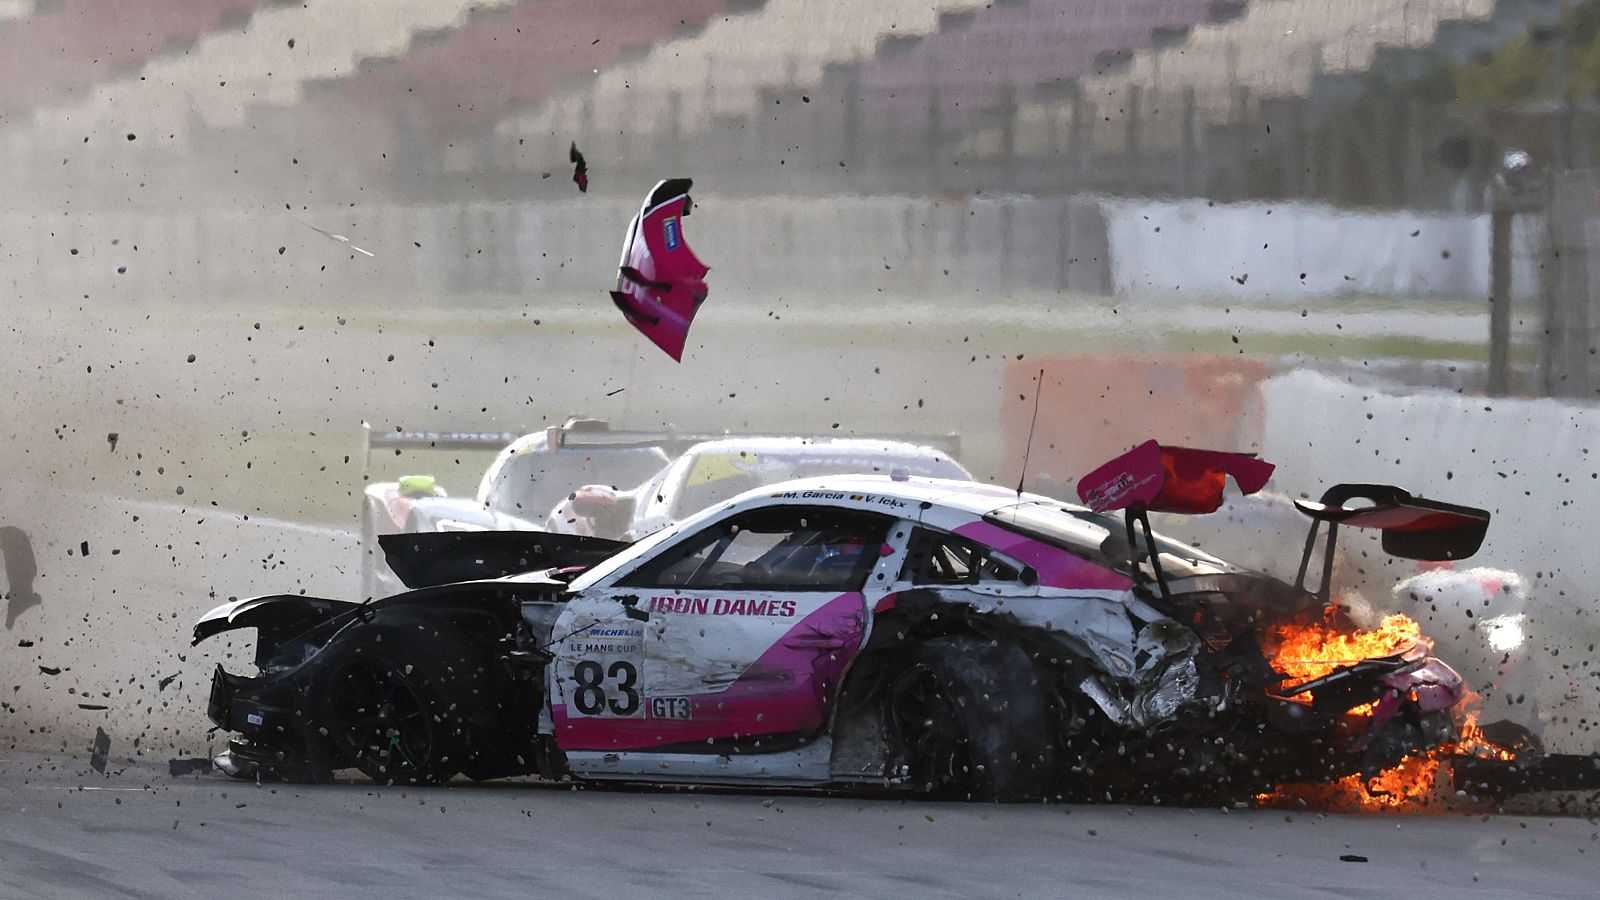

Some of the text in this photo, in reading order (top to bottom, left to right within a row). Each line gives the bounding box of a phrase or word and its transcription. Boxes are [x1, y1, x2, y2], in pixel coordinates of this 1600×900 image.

[783, 491, 799, 499] M.
[865, 494, 907, 508] V. Ickx
[649, 596, 798, 618] IRON DAMES
[589, 629, 644, 637] MICHELIN
[570, 643, 637, 653] LE MANS CUP
[573, 660, 640, 716] 83
[653, 697, 692, 719] GT3
